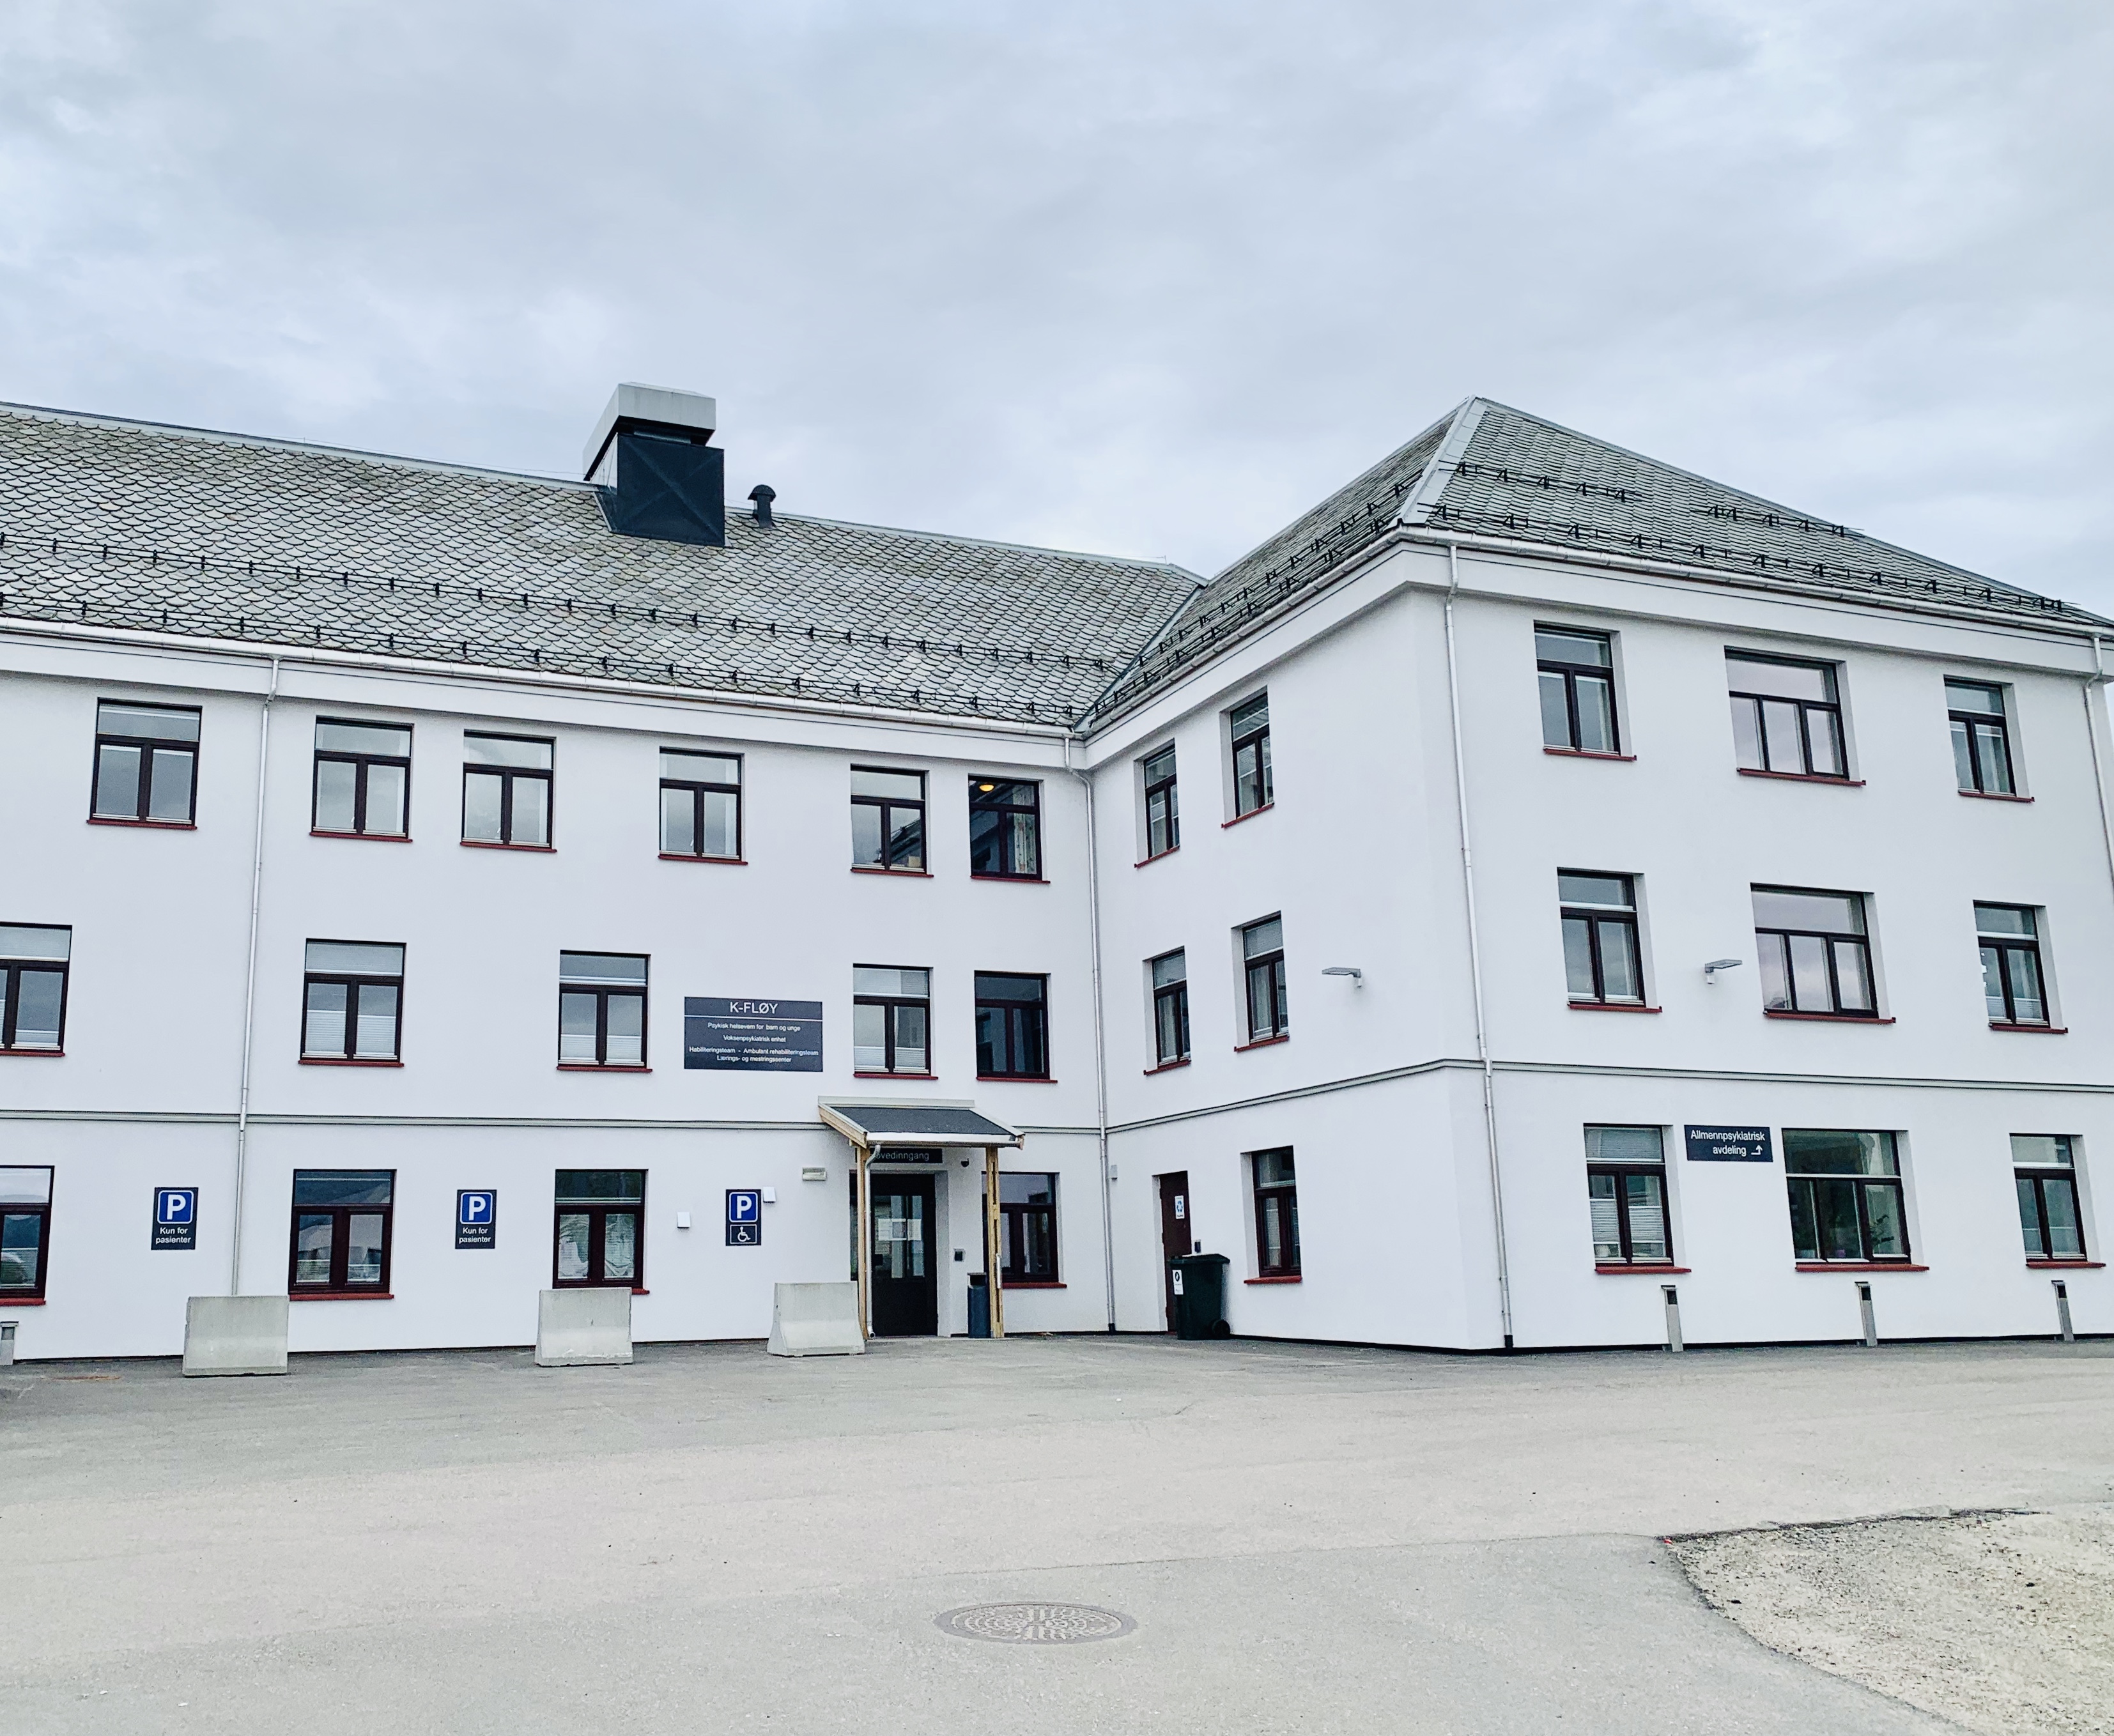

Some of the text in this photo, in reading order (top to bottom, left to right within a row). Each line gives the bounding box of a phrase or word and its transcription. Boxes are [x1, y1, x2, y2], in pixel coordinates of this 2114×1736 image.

[730, 1002, 778, 1014] K-FLØY
[723, 1034, 770, 1043] Voksenpsykiatrisk
[769, 1049, 819, 1057] rehabiliteringsteam
[1690, 1129, 1766, 1143] Allmennpsykiatrisk
[870, 1151, 929, 1161] ovedinngang
[1713, 1145, 1747, 1157] avdeling
[167, 1194, 186, 1220] P
[468, 1195, 486, 1221] P
[736, 1195, 752, 1219] P
[155, 1236, 192, 1245] pasienter
[459, 1236, 491, 1245] pasienter
